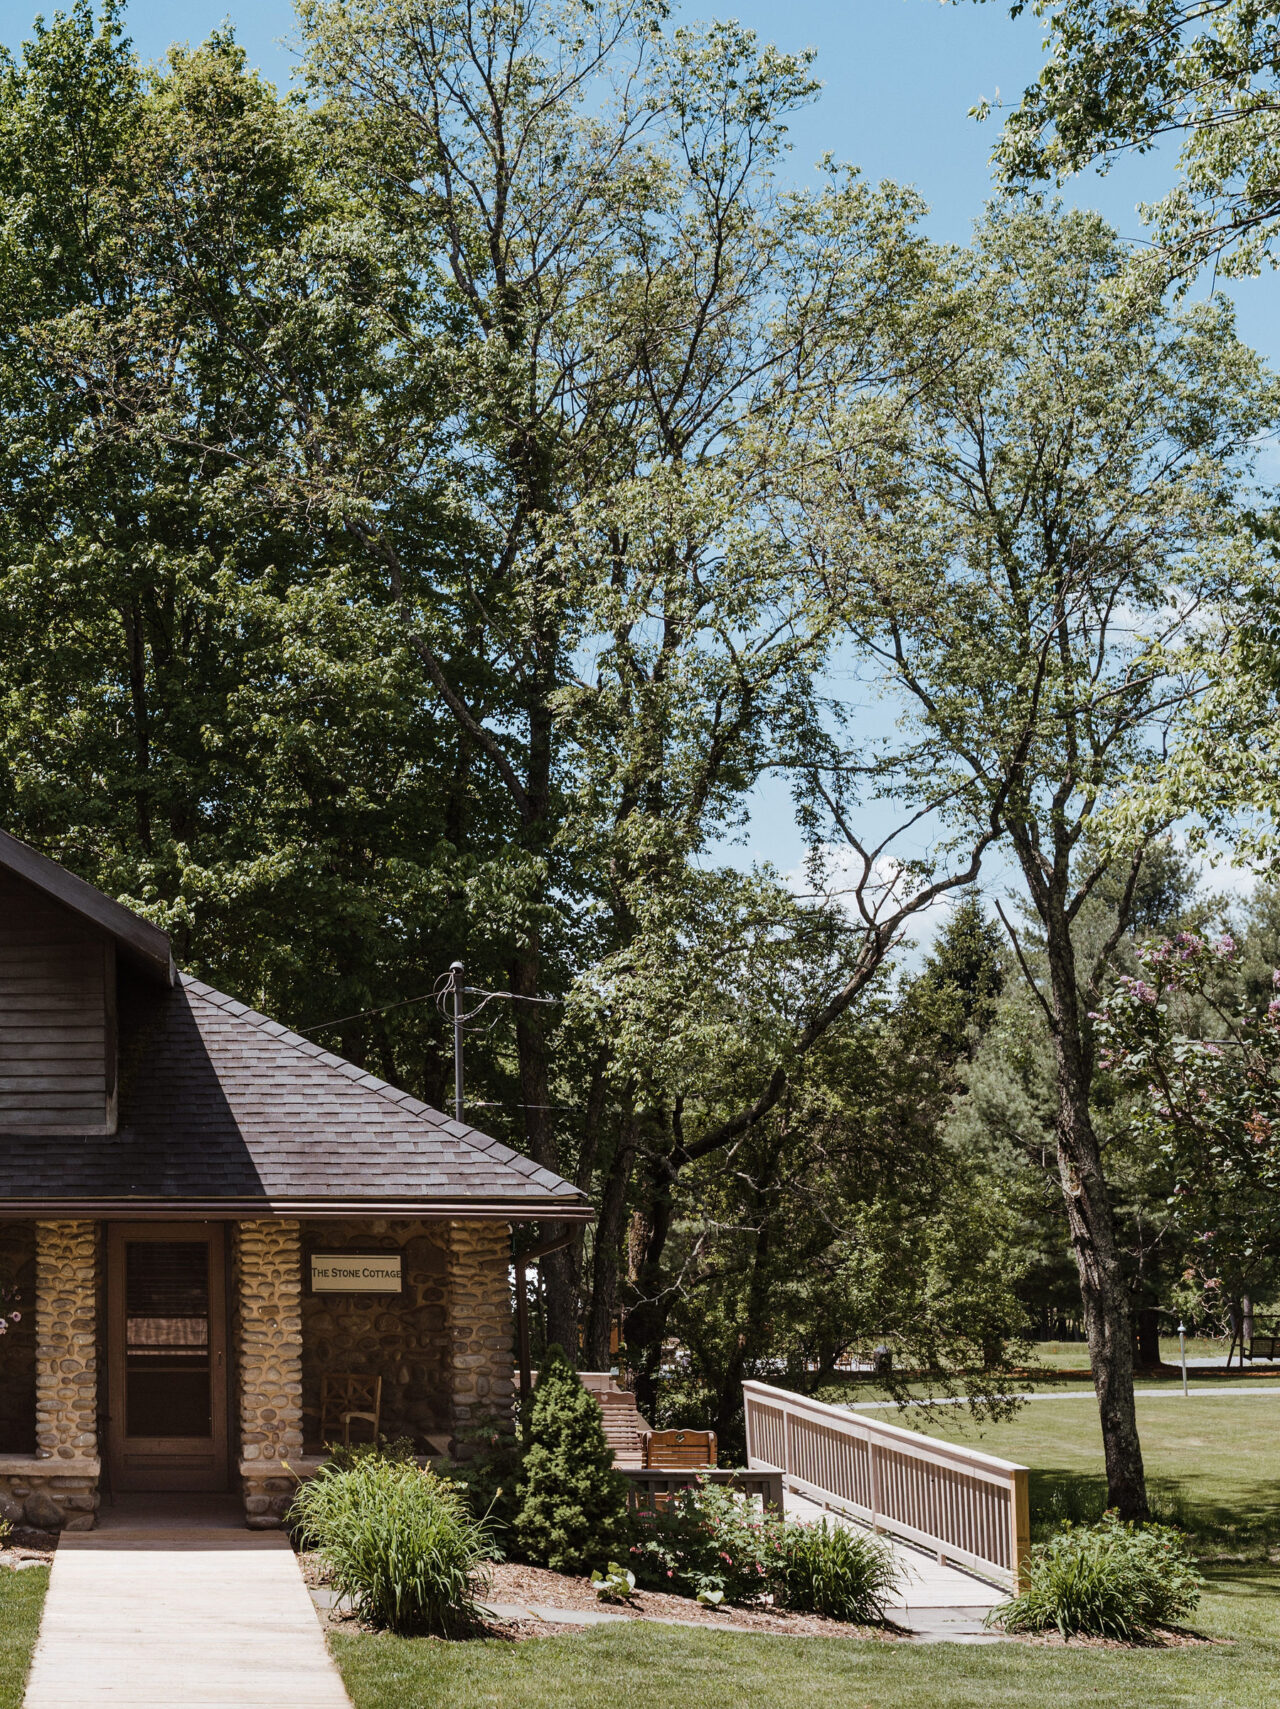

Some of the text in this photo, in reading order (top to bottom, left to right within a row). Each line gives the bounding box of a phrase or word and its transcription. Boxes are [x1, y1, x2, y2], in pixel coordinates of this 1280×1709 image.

[312, 1268, 401, 1279] THE STONE COTTAGE
